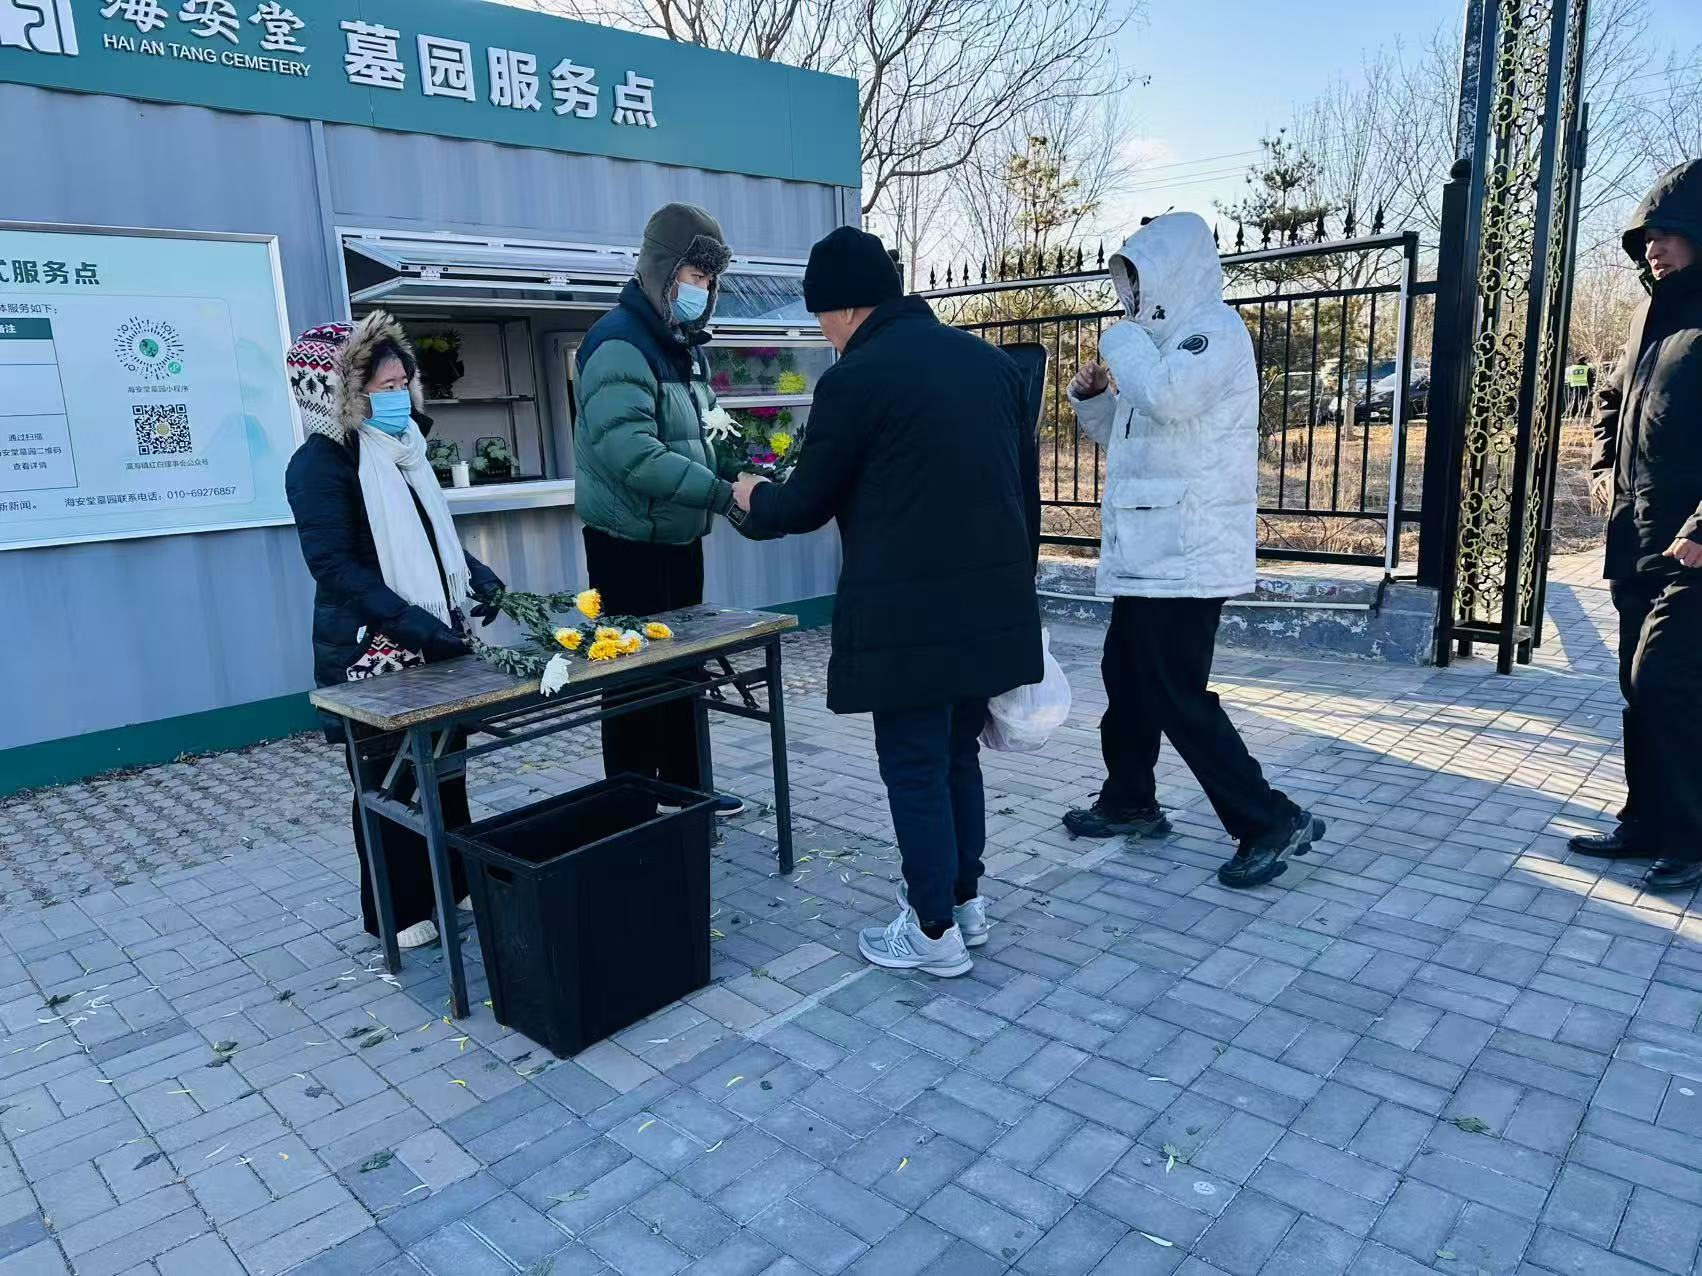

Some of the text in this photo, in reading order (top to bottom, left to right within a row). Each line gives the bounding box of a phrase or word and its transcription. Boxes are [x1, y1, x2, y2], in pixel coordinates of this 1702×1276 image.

[100, 0, 307, 53] 海安堂
[103, 34, 312, 77] HAI AN TANG CEMETERY
[340, 20, 658, 128] 墓园服务点
[8, 433, 43, 441] 通过扫描
[0, 447, 62, 456] 安堂墓园二维码
[13, 461, 48, 470] 查看详情
